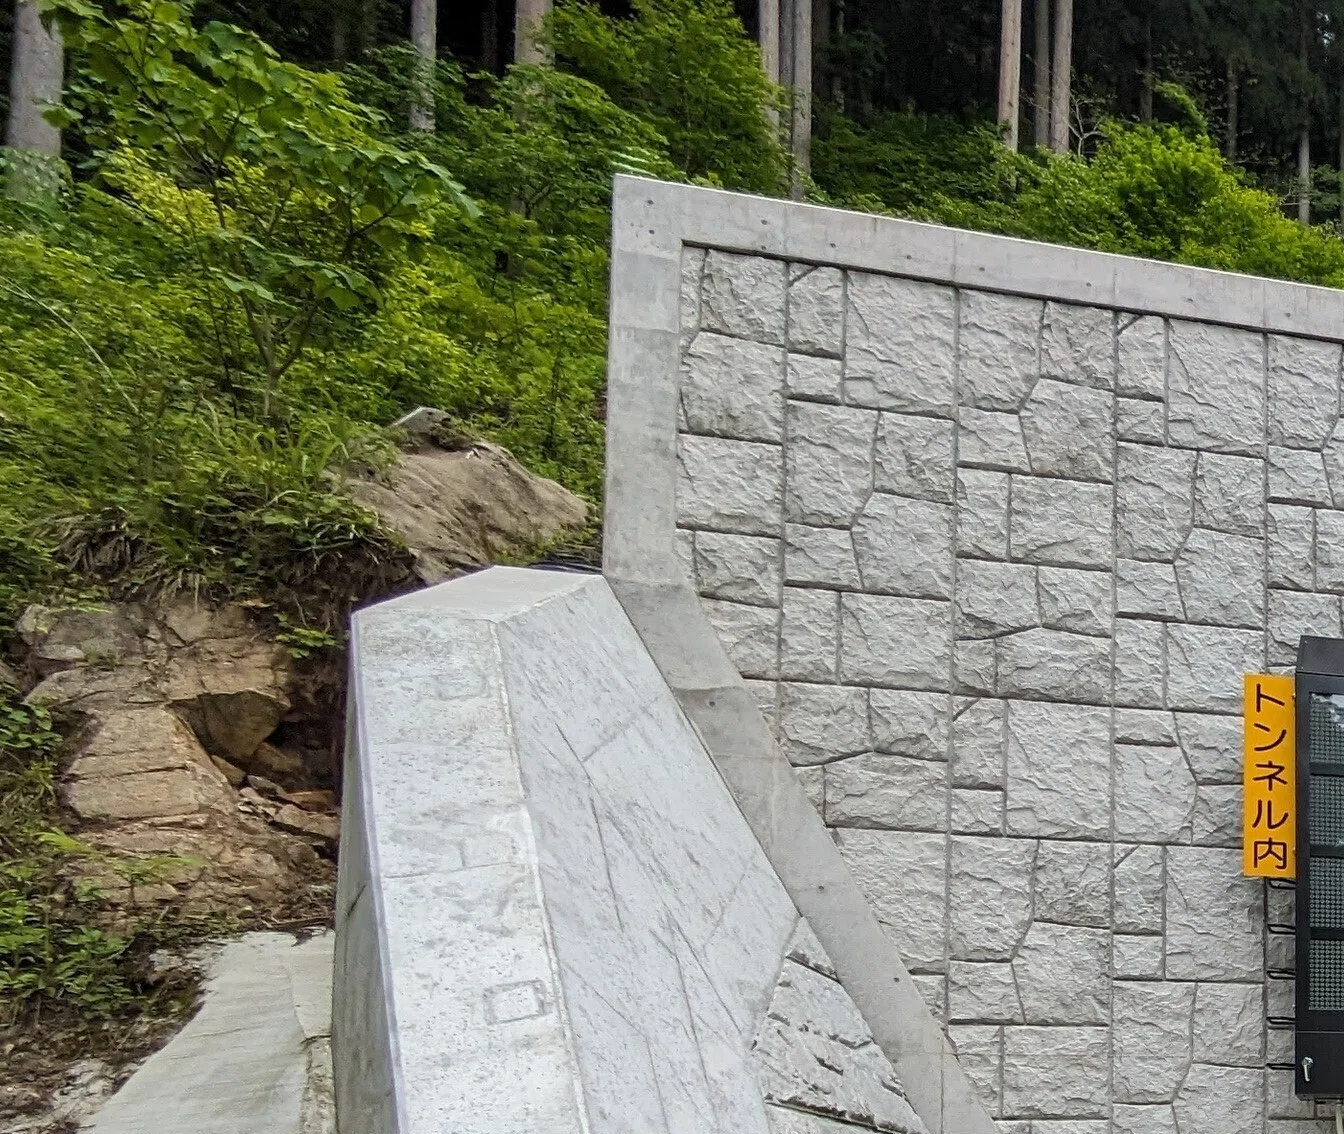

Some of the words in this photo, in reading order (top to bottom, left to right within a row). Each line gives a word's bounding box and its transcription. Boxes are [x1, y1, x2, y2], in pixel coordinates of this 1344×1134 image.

[1252, 683, 1289, 870] トンネル内
